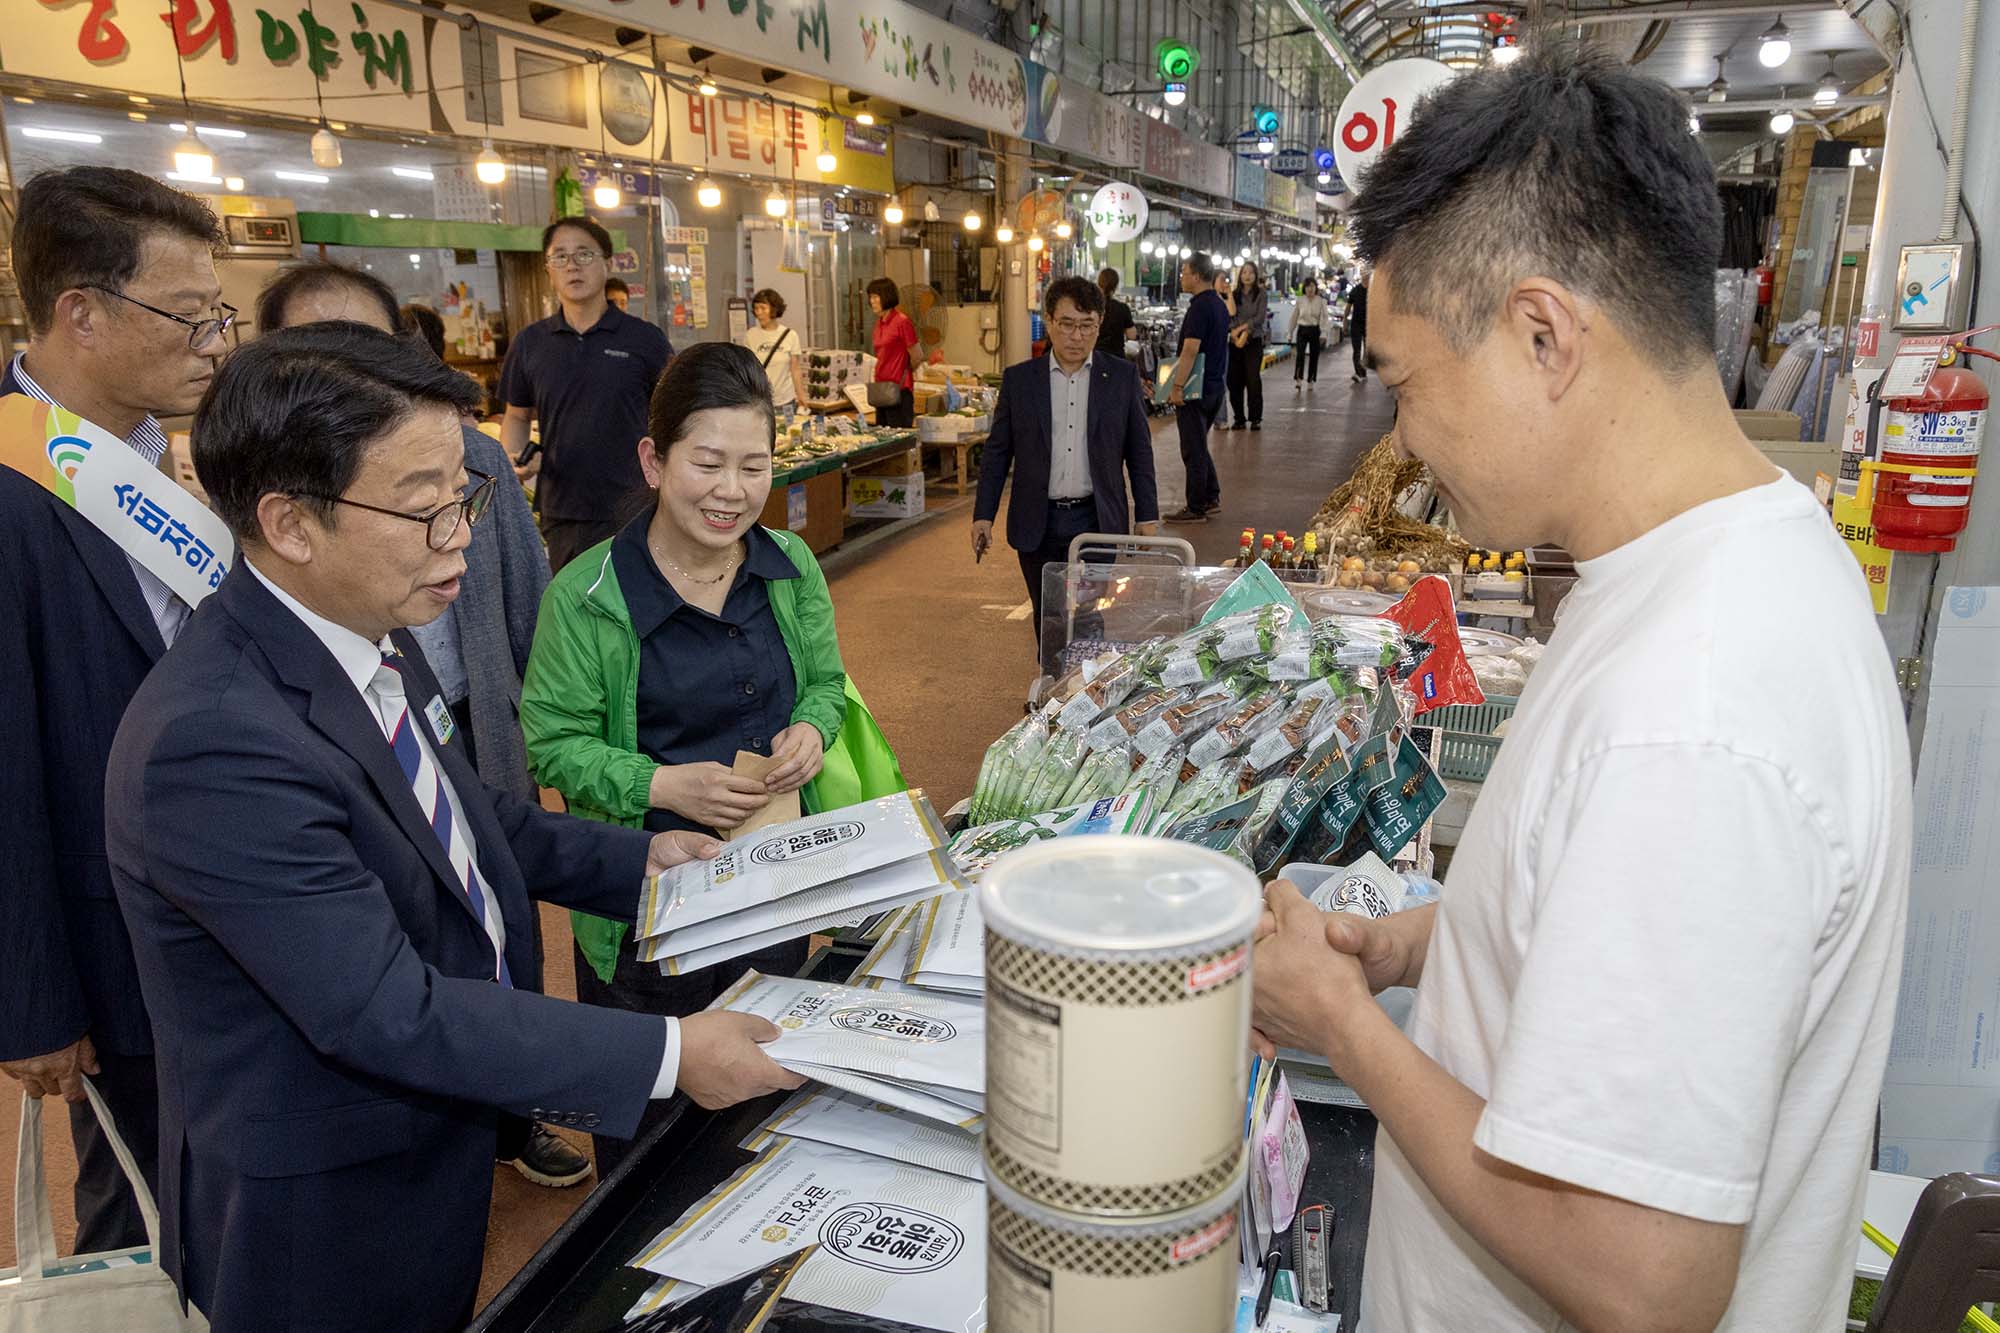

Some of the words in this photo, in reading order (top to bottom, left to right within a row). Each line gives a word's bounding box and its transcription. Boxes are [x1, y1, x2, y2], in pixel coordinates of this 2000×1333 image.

[255, 2, 412, 96] 야채
[688, 94, 808, 168] 비닐봉투
[1095, 209, 1137, 229] 야채
[1920, 411, 1940, 435] SW
[1939, 415, 1966, 428] 3.3kg
[113, 483, 216, 576] 소비자의
[1836, 522, 1874, 546] 오토바
[1284, 812, 1300, 829] YUK
[1328, 814, 1344, 832] YUK
[1379, 833, 1395, 852] YUK
[789, 996, 825, 1018] 곱창김
[776, 1185, 831, 1225] 곱창김
[857, 1216, 906, 1253] 상회
[888, 1222, 935, 1260] 해풍
[919, 1234, 952, 1261] 김미경
